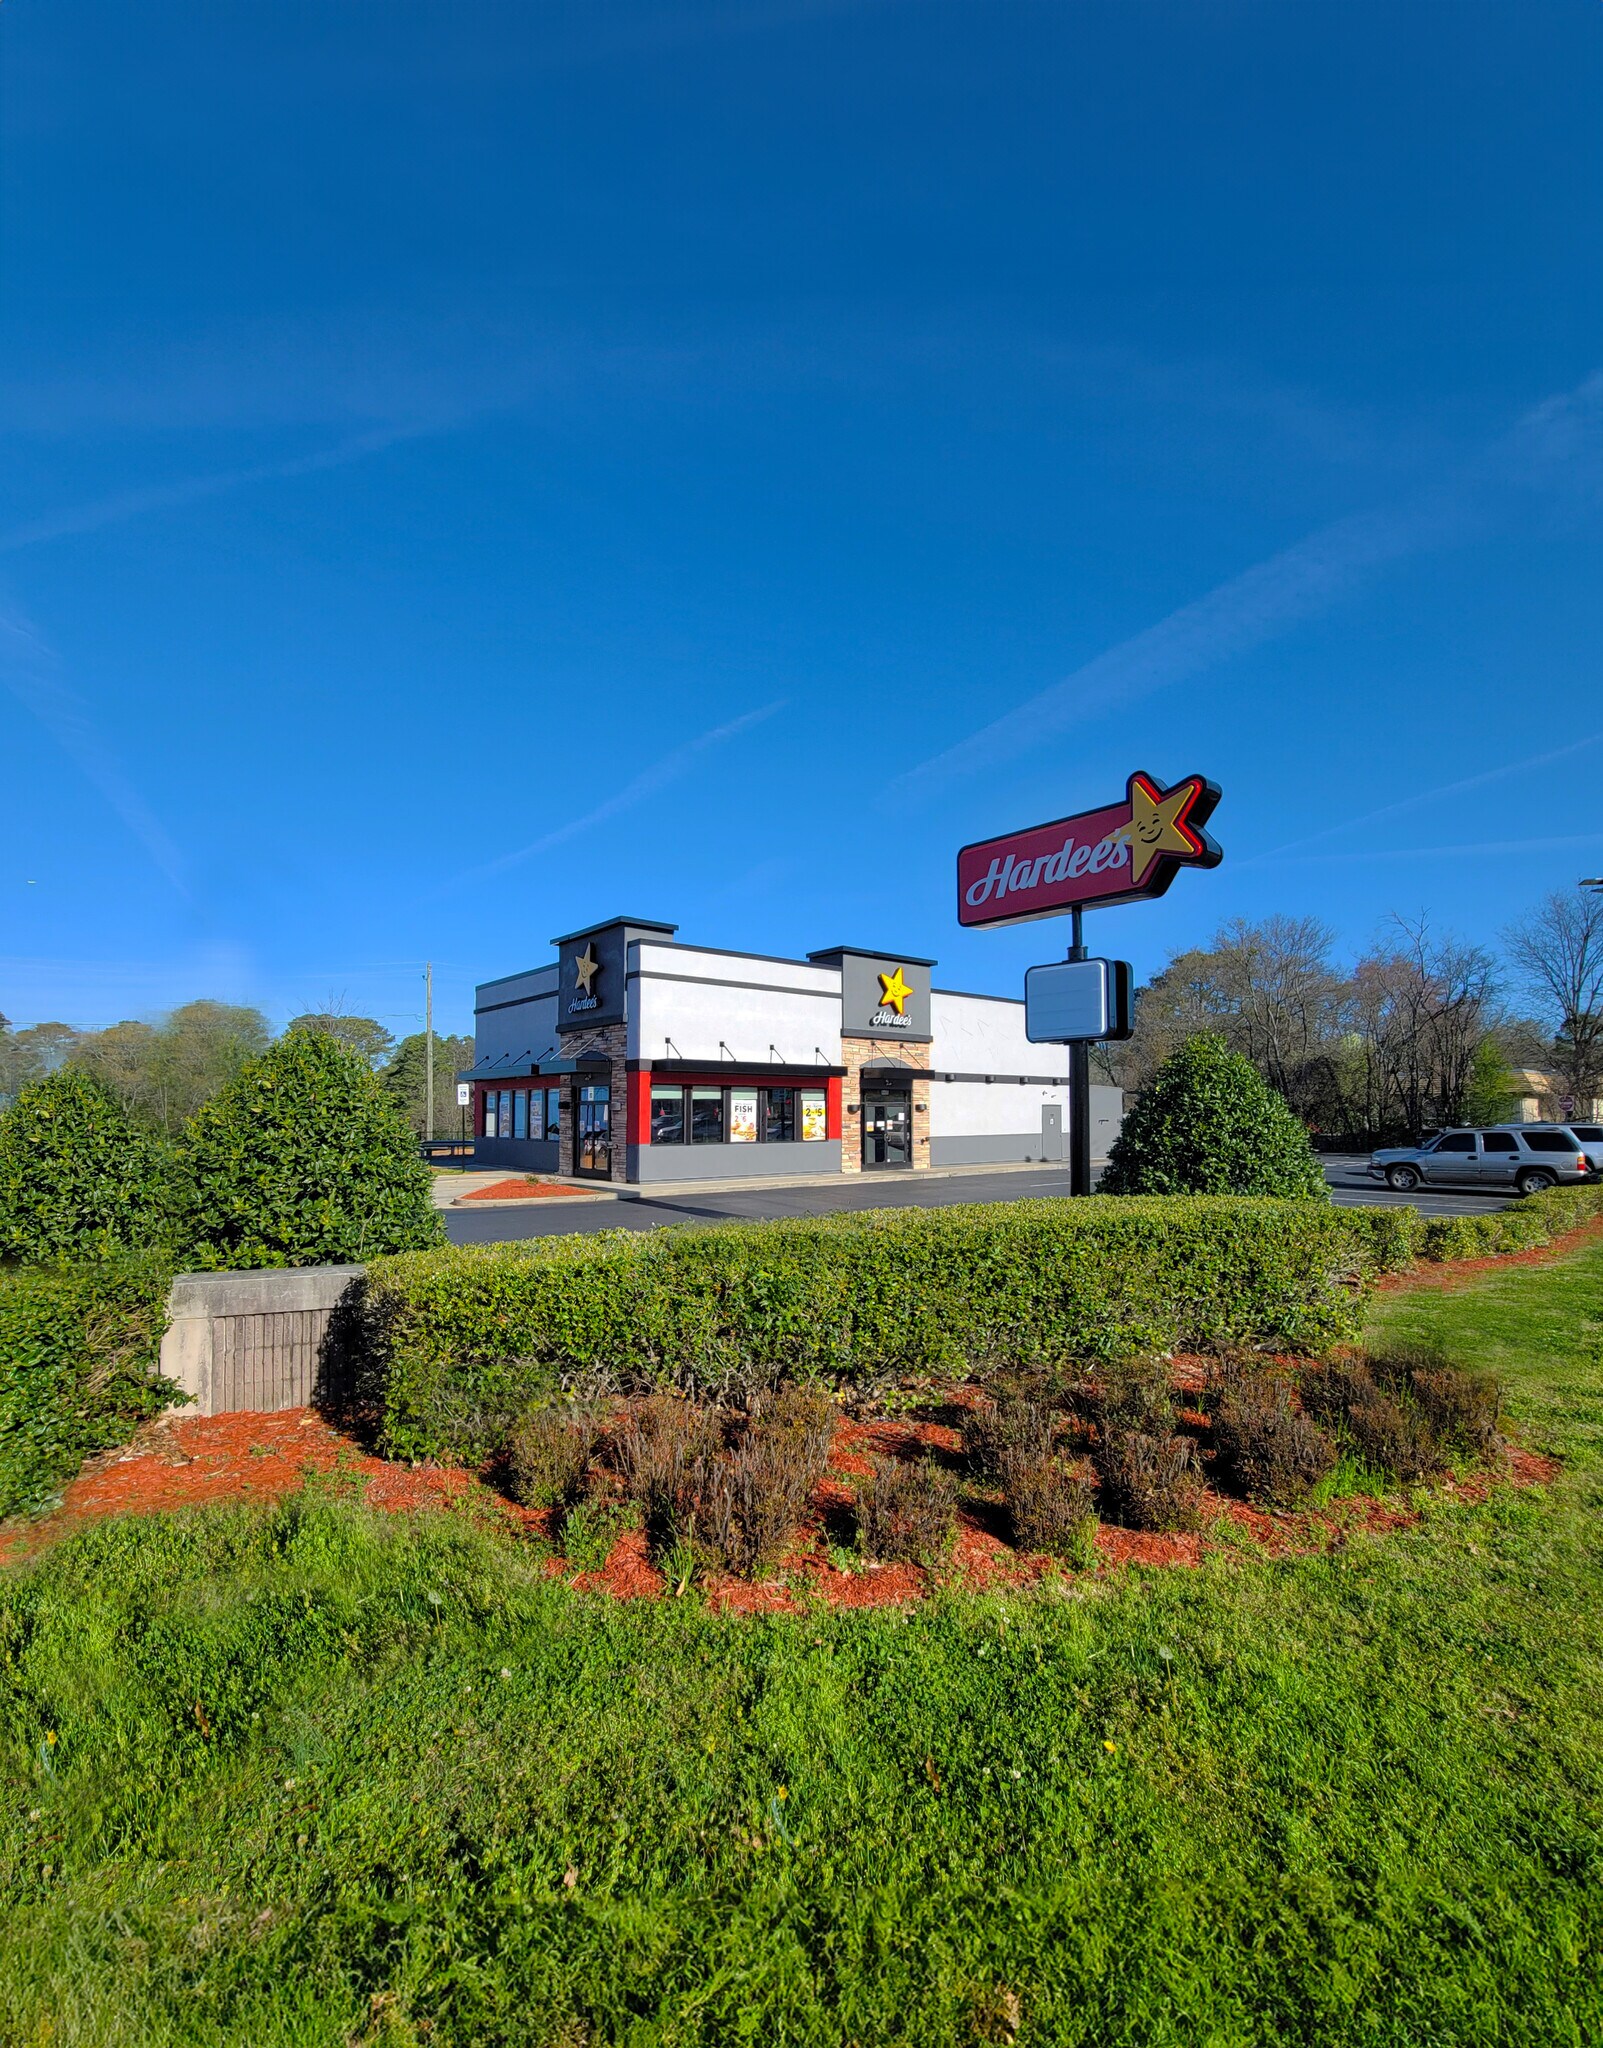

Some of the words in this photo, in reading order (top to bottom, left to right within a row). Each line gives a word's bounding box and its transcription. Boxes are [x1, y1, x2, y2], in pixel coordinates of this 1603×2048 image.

[966, 828, 1131, 905] Hardee's
[568, 994, 597, 1014] Hardee's
[873, 1011, 912, 1026] Hardee's
[734, 1105, 753, 1113] FISH
[805, 1107, 812, 1117] 2
